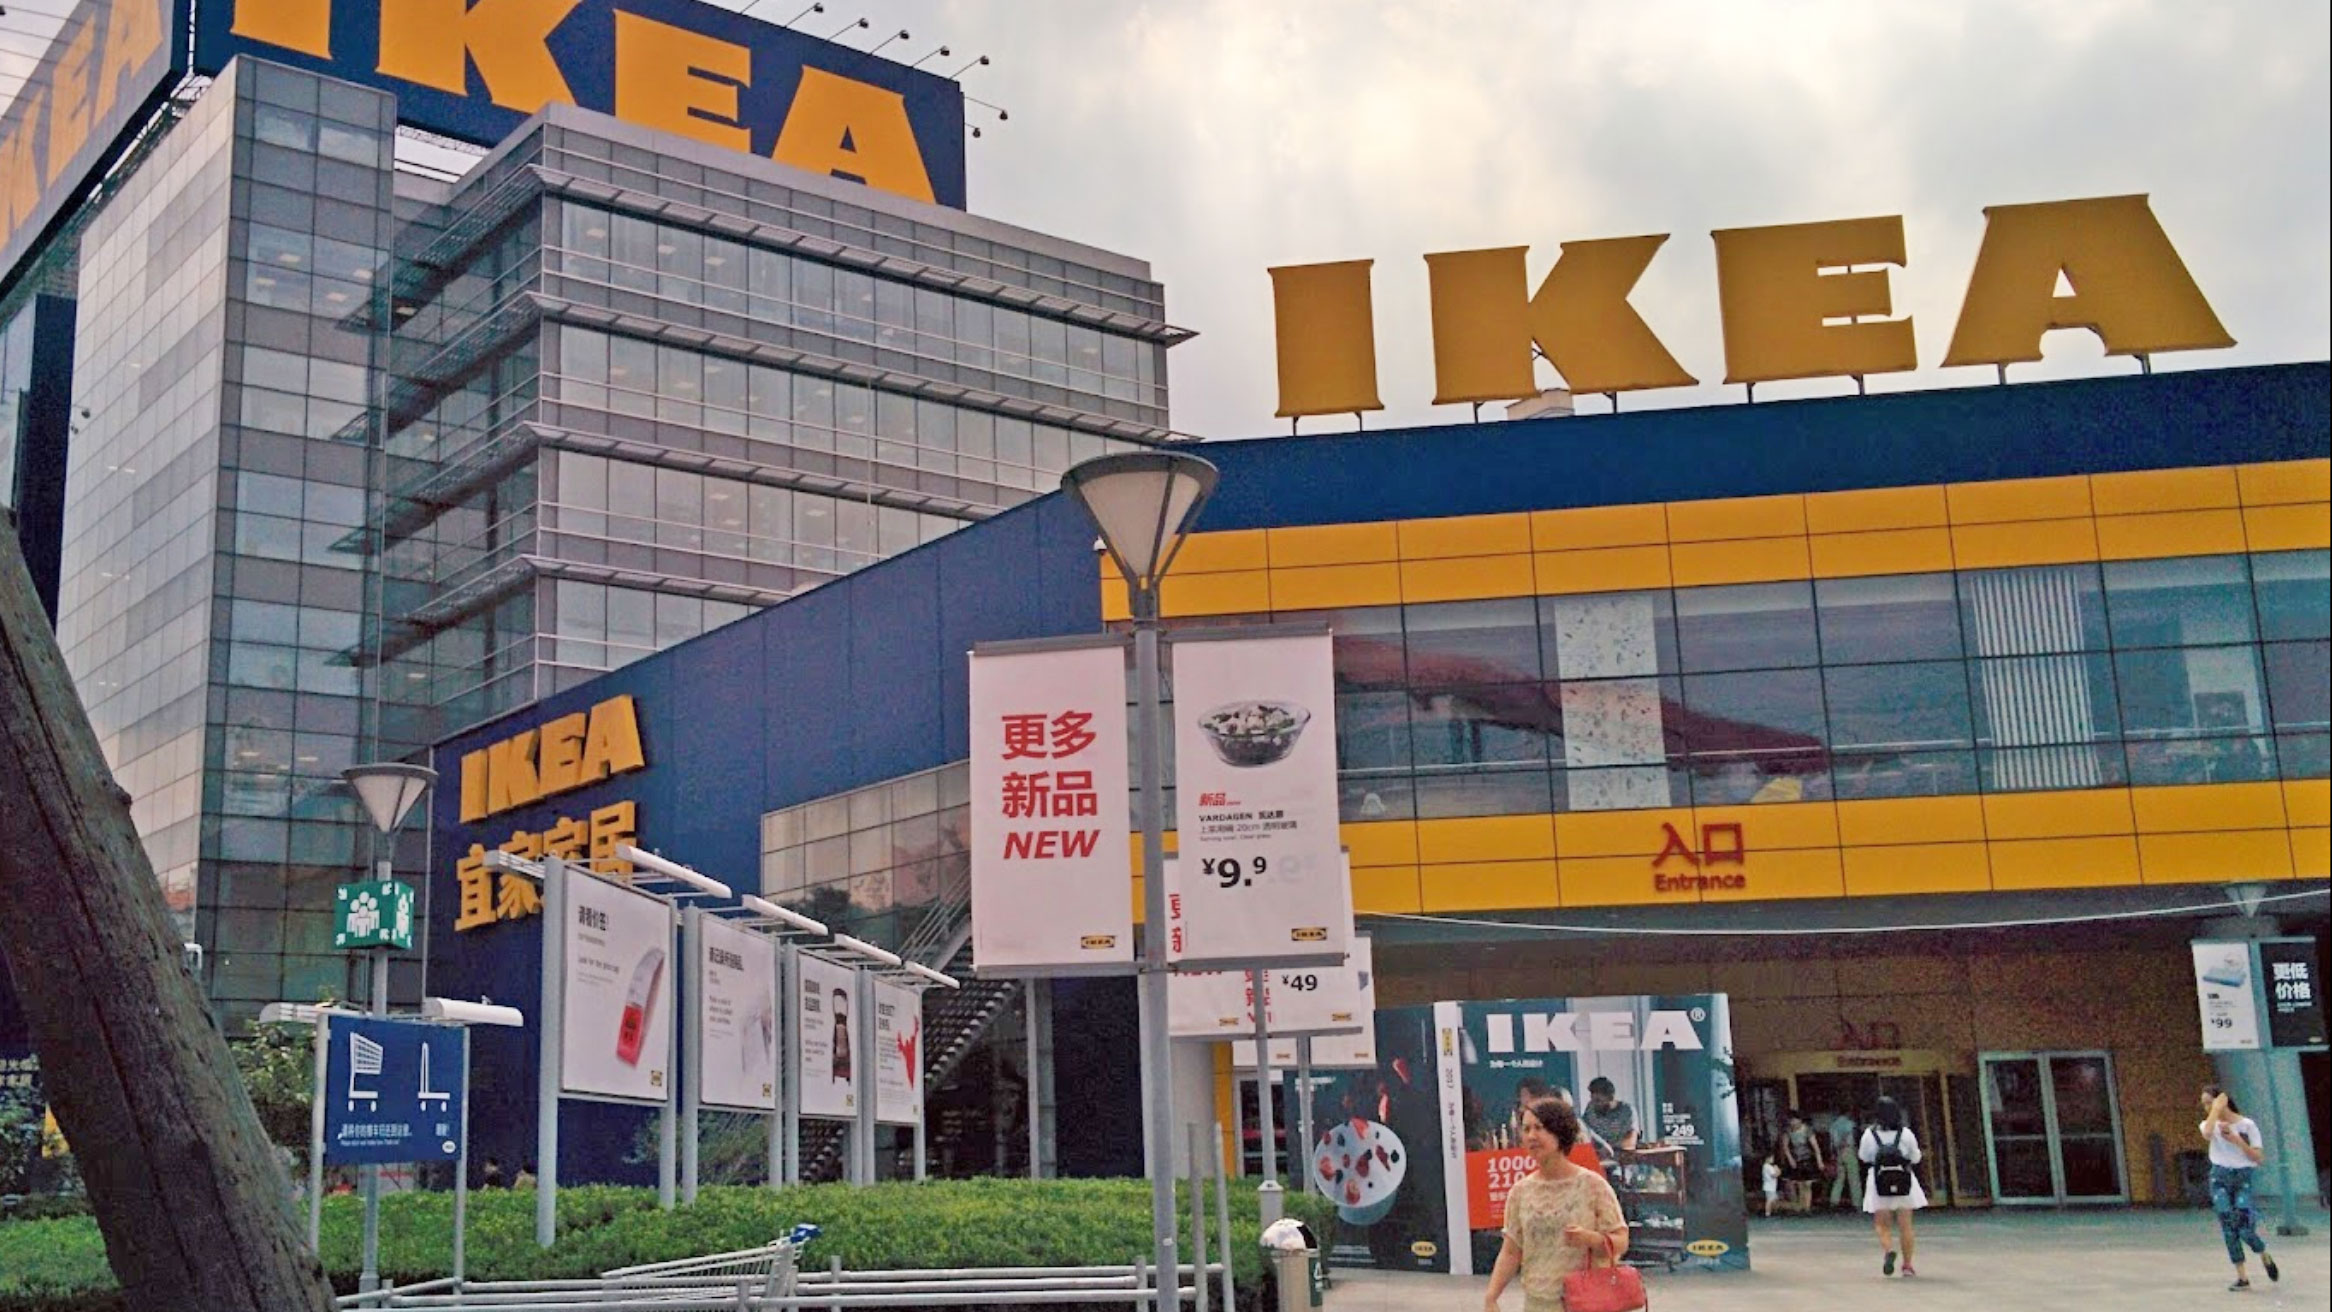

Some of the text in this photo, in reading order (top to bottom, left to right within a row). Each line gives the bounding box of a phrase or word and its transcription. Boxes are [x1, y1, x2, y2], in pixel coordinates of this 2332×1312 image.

[1267, 193, 2237, 416] IKEA
[1002, 711, 1097, 760] 更多
[459, 694, 645, 824] IKEA
[1002, 771, 1097, 818] 新品
[1199, 812, 1253, 822] VARDAGEN
[1003, 829, 1101, 860] NEW
[1651, 822, 1745, 867] 入口
[1654, 872, 1746, 892] Entrance
[1281, 974, 1318, 991] ¥49
[2272, 962, 2309, 980] 更低
[2275, 982, 2311, 1000] 价格
